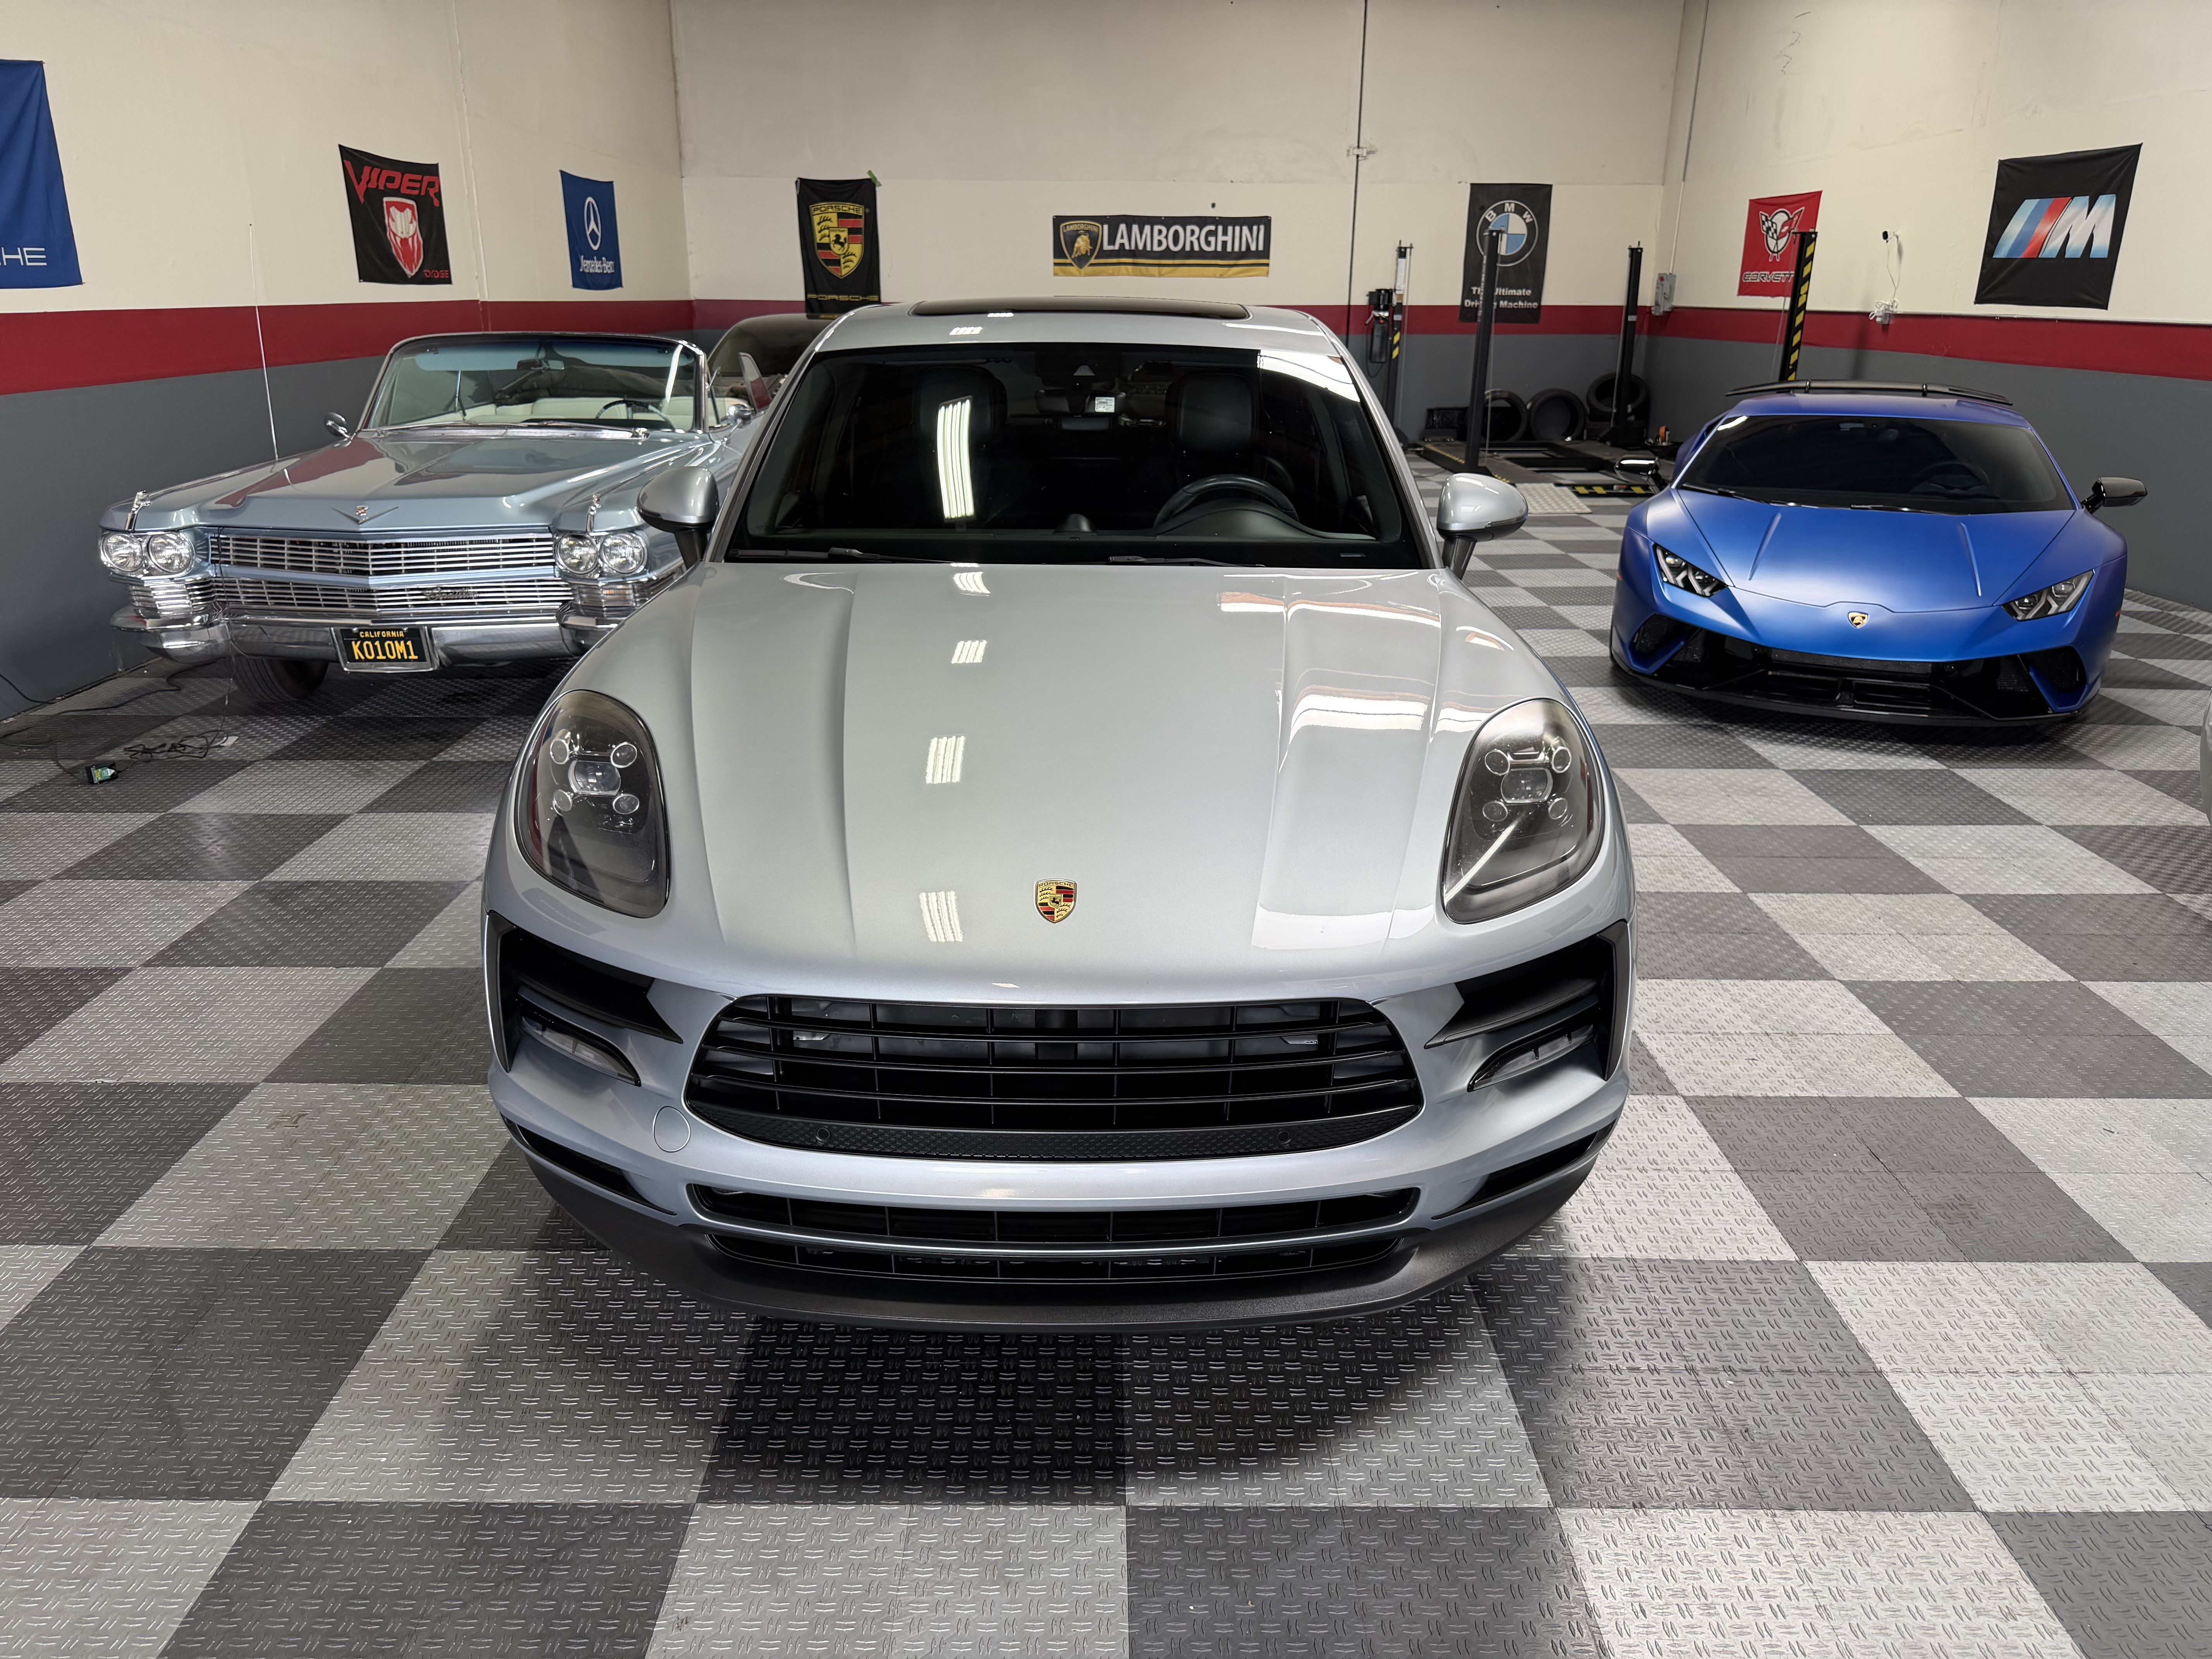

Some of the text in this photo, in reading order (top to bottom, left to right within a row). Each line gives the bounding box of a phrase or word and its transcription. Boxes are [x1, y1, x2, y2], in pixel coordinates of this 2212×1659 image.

[343, 160, 440, 207] VIPER
[814, 205, 860, 214] PORSCHE
[1486, 202, 1534, 223] BMW
[1102, 224, 1265, 251] LAMBORGHINI
[0, 247, 47, 266] HE
[1742, 271, 1795, 282] CORVETT
[1499, 301, 1539, 309] Machine
